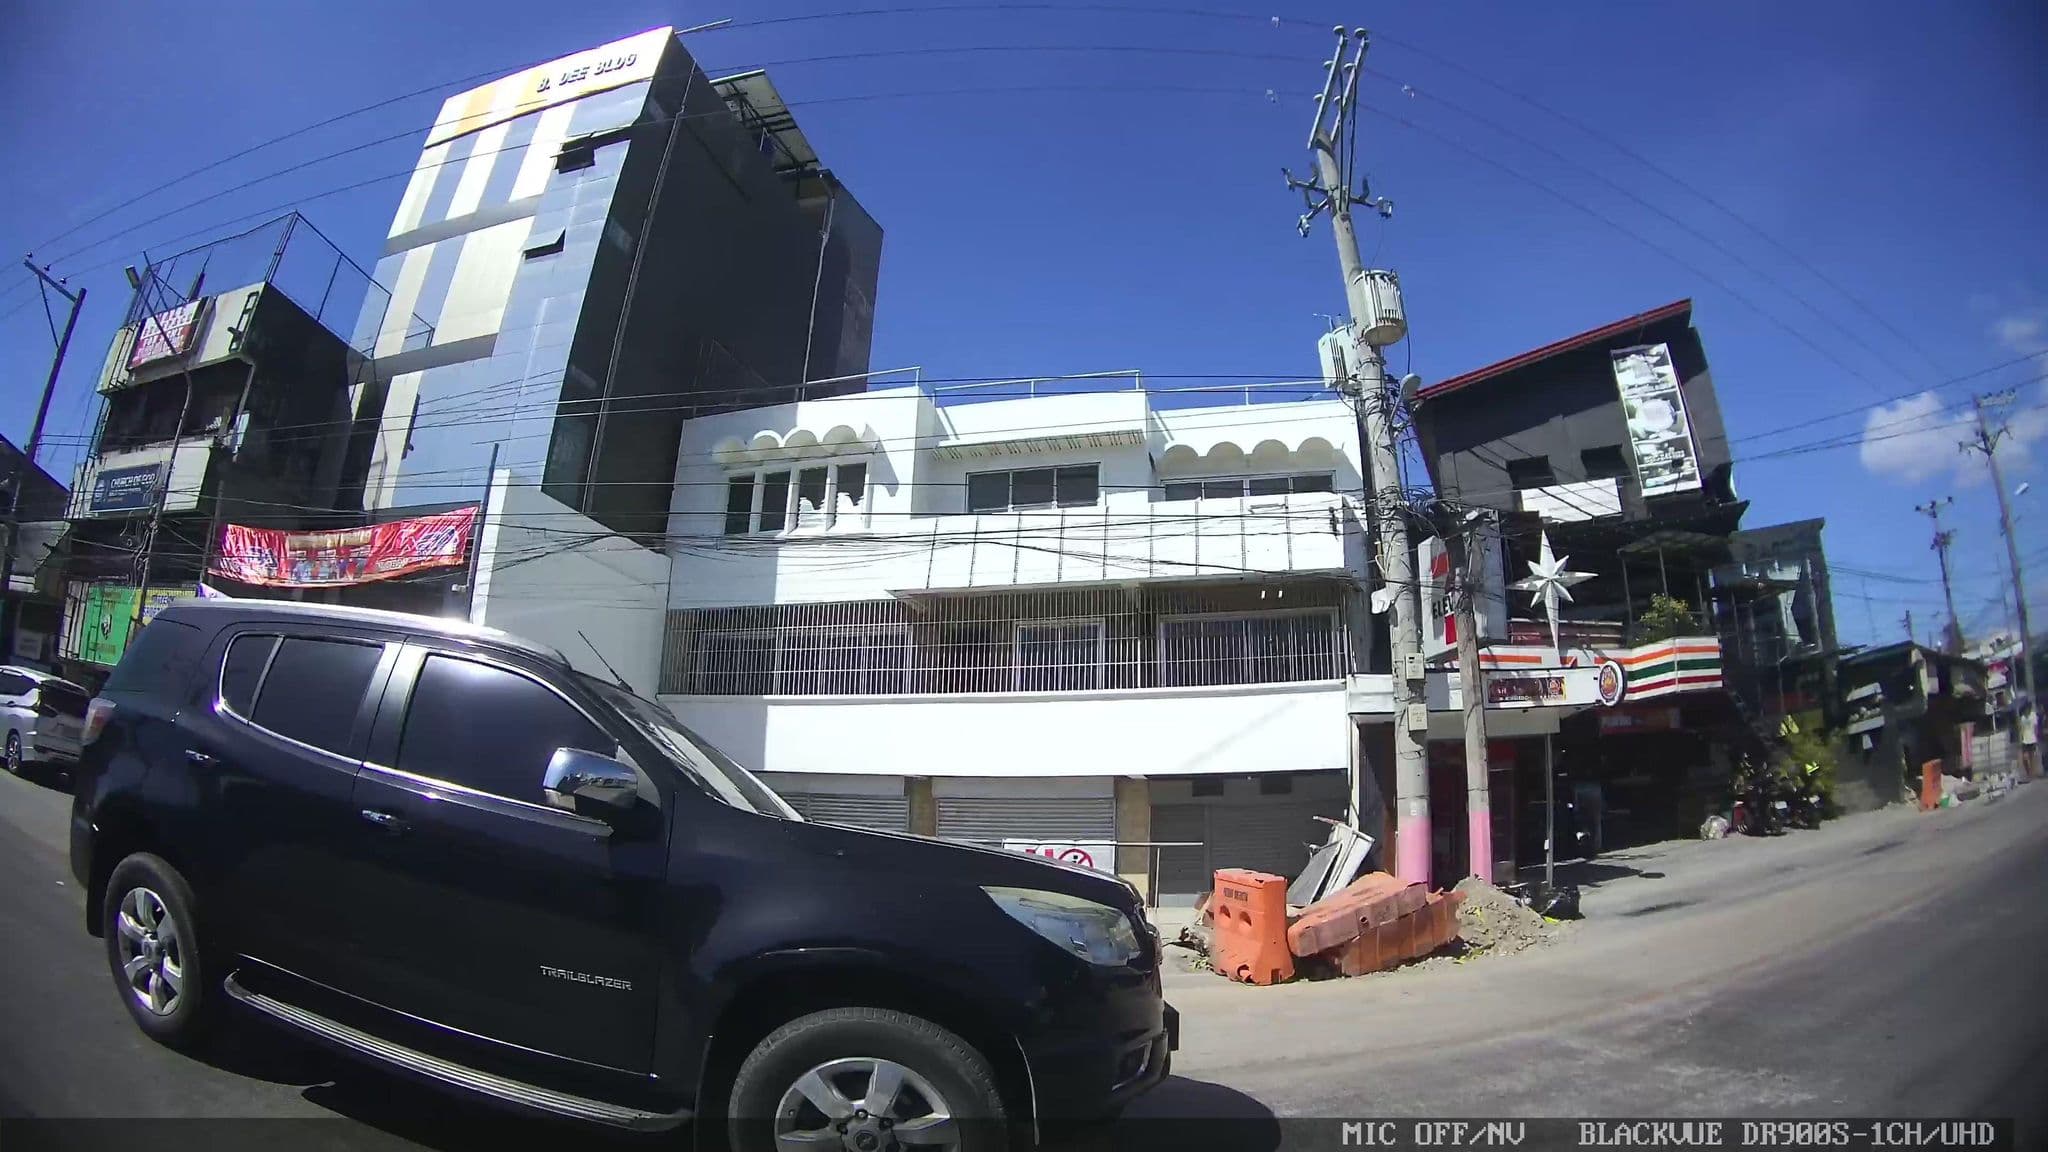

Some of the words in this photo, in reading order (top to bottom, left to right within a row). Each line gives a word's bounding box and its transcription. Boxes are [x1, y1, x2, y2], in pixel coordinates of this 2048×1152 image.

[559, 66, 590, 86] DEE
[594, 54, 637, 75] BLDG
[540, 965, 632, 990] TRAILBLAZER
